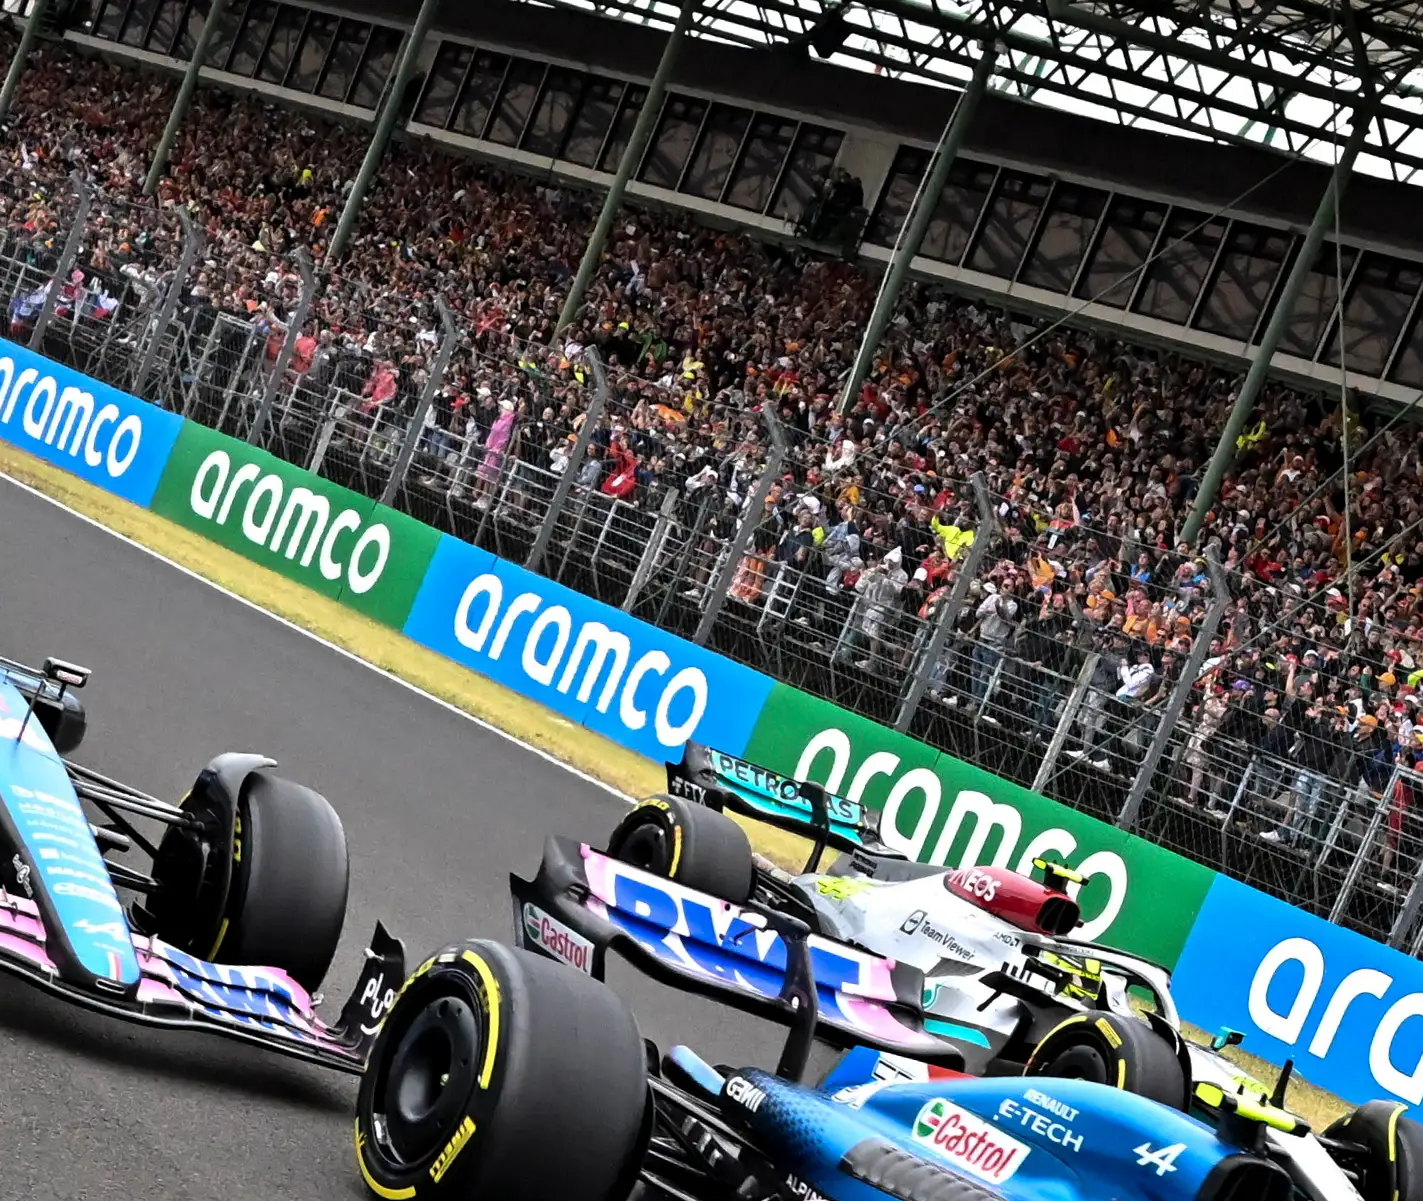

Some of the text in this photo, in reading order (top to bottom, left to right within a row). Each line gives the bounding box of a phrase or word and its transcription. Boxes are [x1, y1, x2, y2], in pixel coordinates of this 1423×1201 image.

[190, 449, 391, 594] aramco
[454, 574, 708, 747] aramco
[720, 756, 853, 818] PETROAS
[949, 868, 1002, 902] INEOS
[541, 915, 588, 974] Castrol
[608, 873, 861, 1022] BWT
[920, 917, 975, 962] TeamViewer
[998, 1098, 1085, 1153] E-TECH
[1022, 1088, 1080, 1123] RENAULT
[932, 1113, 1017, 1179] Castrol
